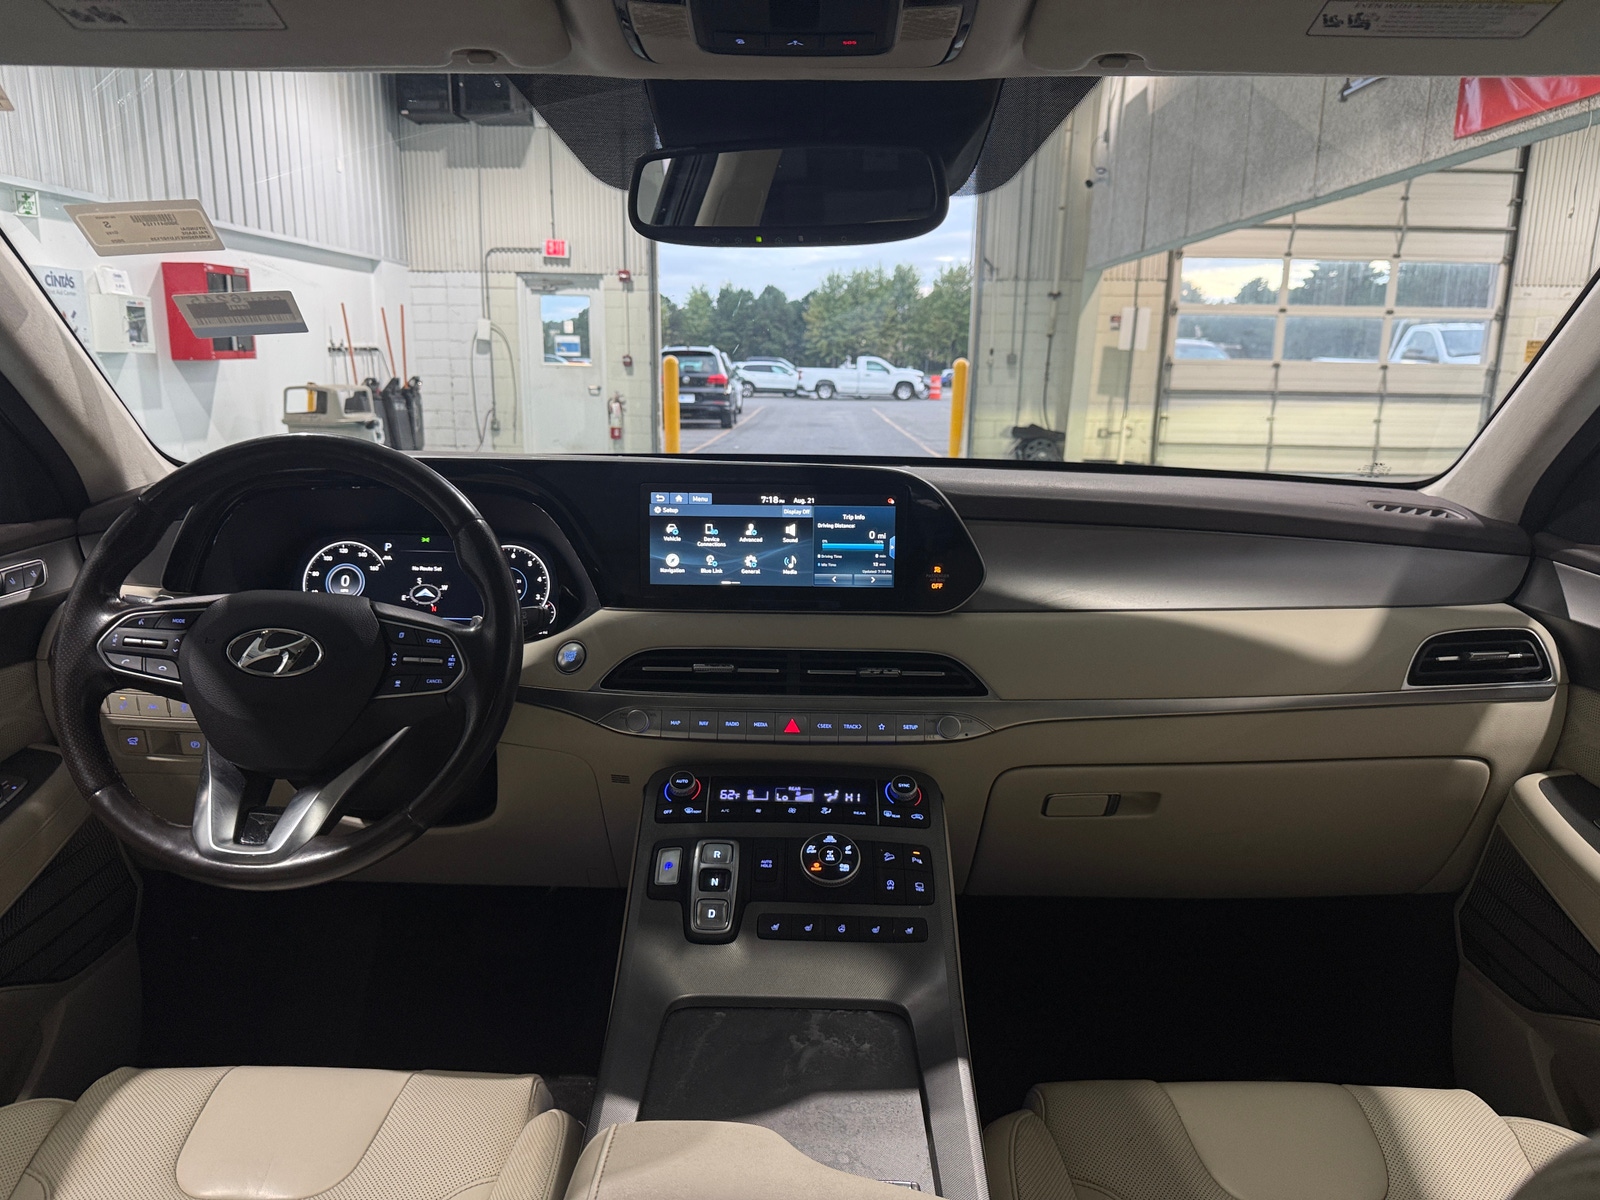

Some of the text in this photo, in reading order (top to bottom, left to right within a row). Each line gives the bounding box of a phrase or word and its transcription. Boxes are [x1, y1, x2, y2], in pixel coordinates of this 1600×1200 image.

[546, 240, 565, 256] EXIT
[869, 531, 876, 539] 0
[385, 543, 392, 551] P
[340, 575, 350, 587] 0
[664, 861, 673, 870] P
[710, 878, 718, 886] N
[708, 909, 716, 918] D
